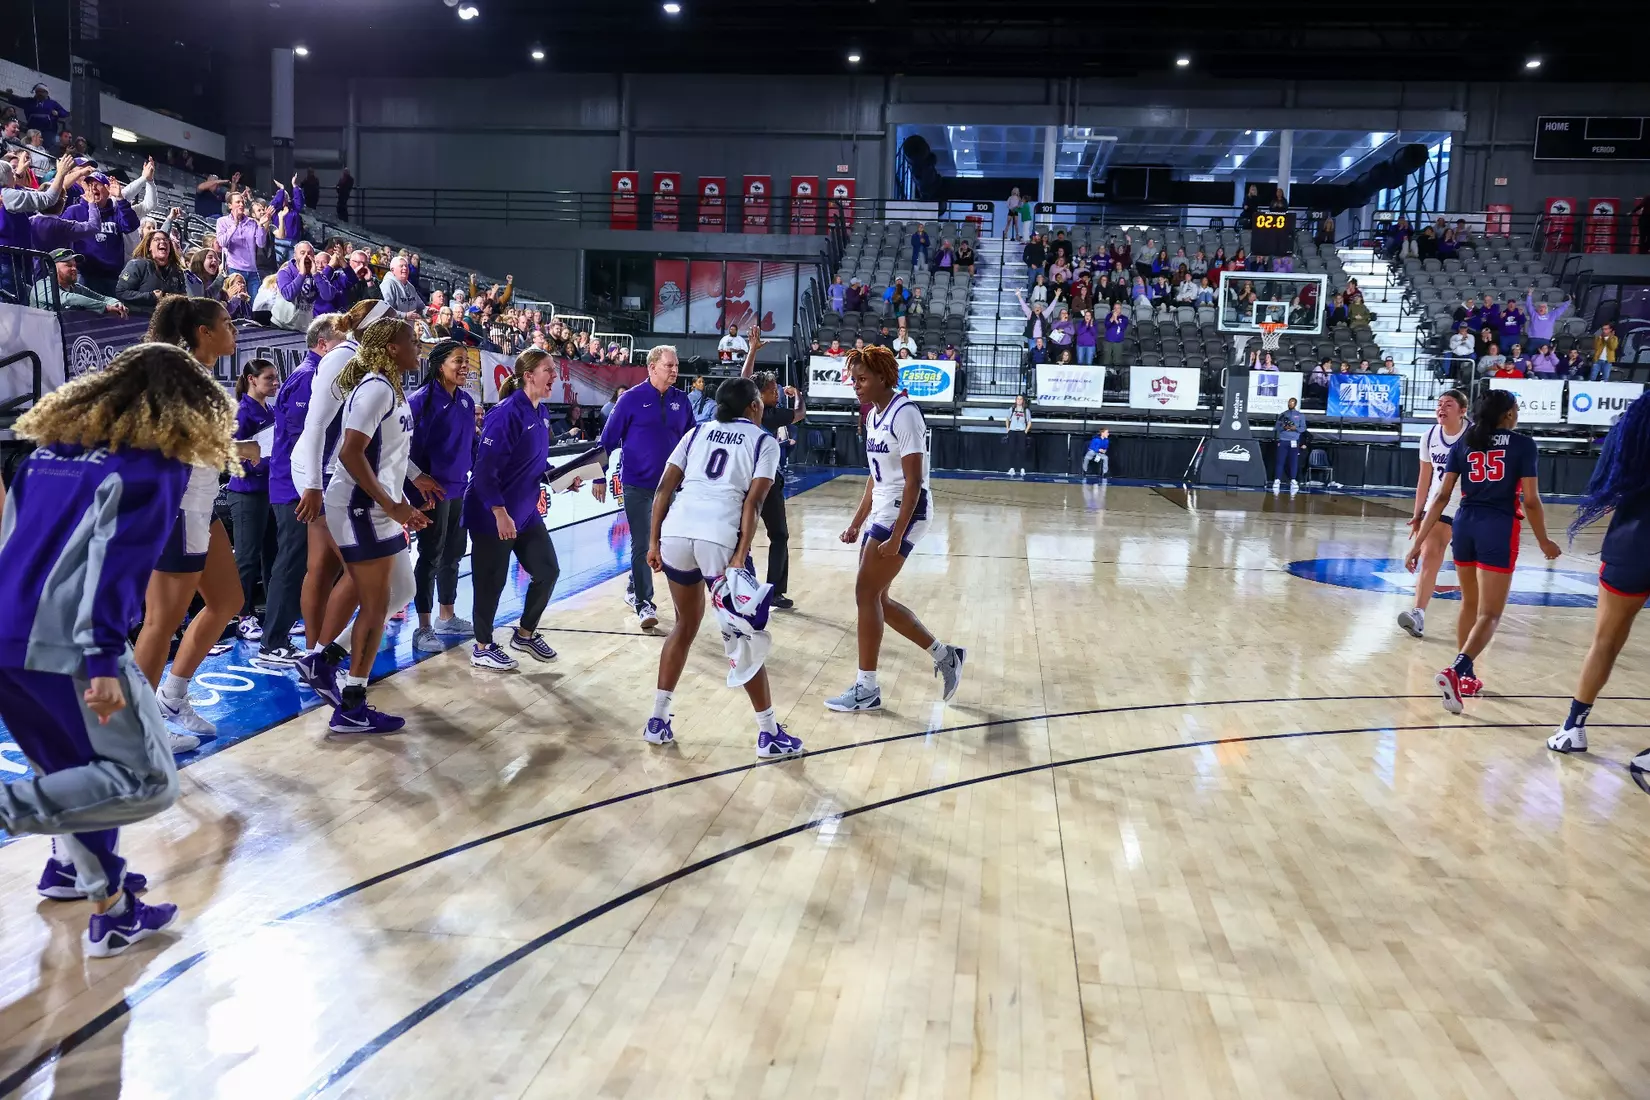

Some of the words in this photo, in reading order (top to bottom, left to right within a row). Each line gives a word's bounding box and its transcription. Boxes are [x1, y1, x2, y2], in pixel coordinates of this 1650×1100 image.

[1545, 122, 1569, 131] HOME
[1256, 215, 1285, 229] 02.0
[903, 370, 942, 382] Fastgas
[1359, 383, 1390, 392] UNITED
[1359, 392, 1389, 402] FIBER
[1232, 392, 1241, 420] Southern
[1519, 400, 1557, 410] AGLE
[706, 429, 746, 445] ARENAS
[1492, 434, 1510, 446] SON
[705, 448, 730, 480] 0
[1467, 449, 1506, 482] 35
